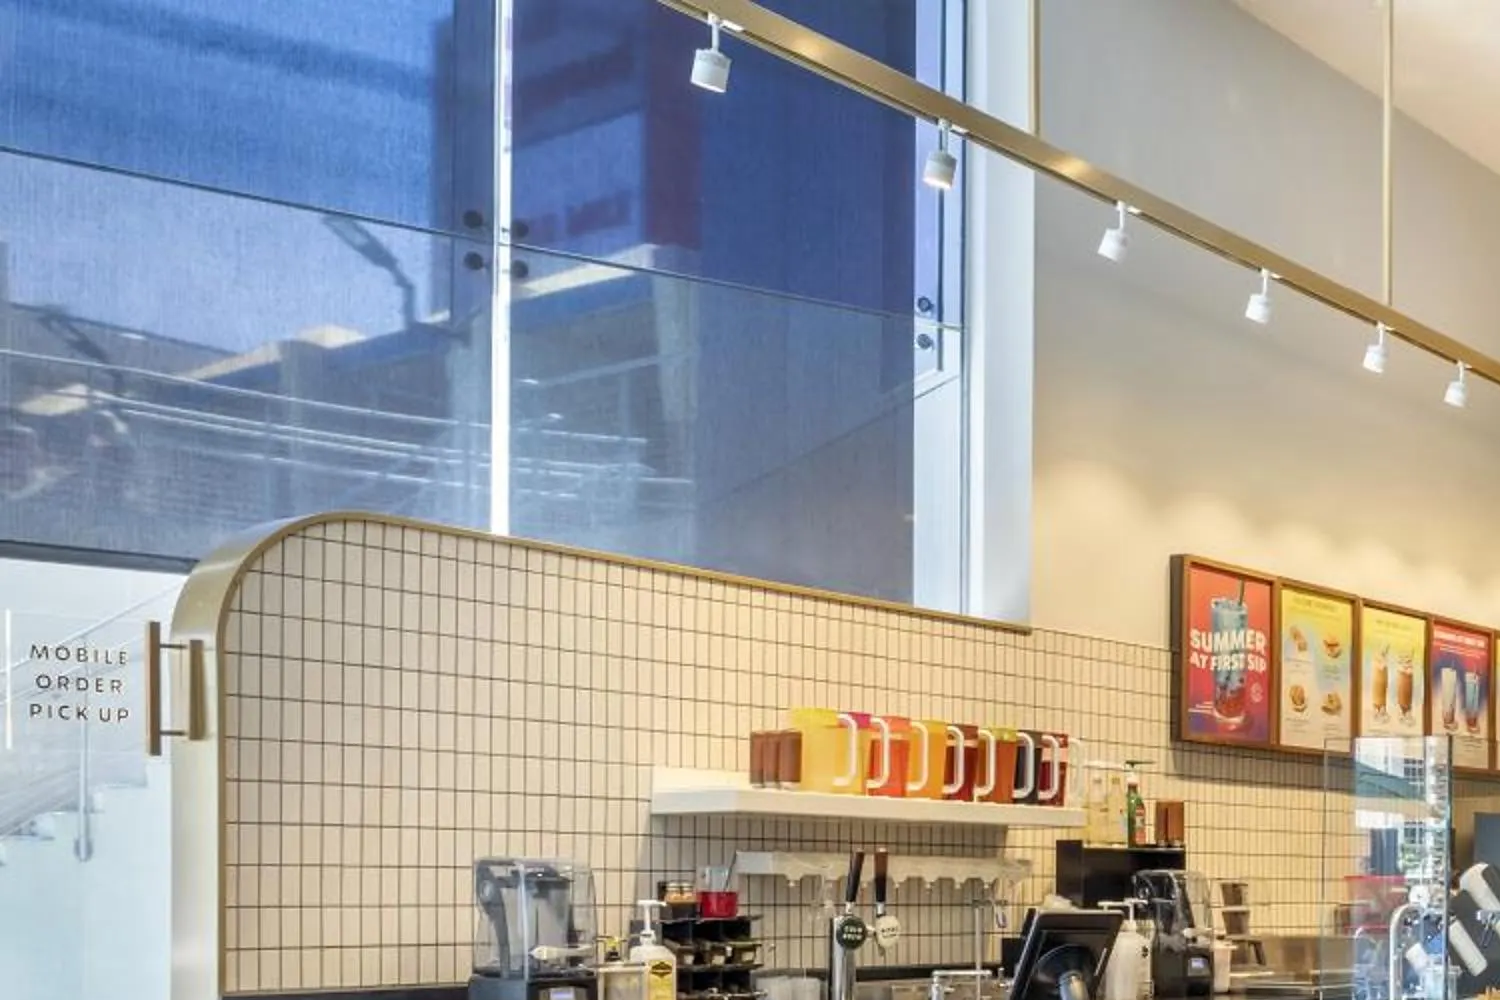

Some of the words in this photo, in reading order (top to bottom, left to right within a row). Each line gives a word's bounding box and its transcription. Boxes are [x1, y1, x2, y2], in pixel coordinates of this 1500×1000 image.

[1190, 628, 1267, 656] SUMMER
[30, 645, 127, 665] MOBILE
[1190, 651, 1209, 669] AT
[1210, 653, 1246, 671] FIRST
[35, 675, 122, 693] ORDER
[29, 703, 88, 721] PICK
[100, 707, 129, 723] UP
